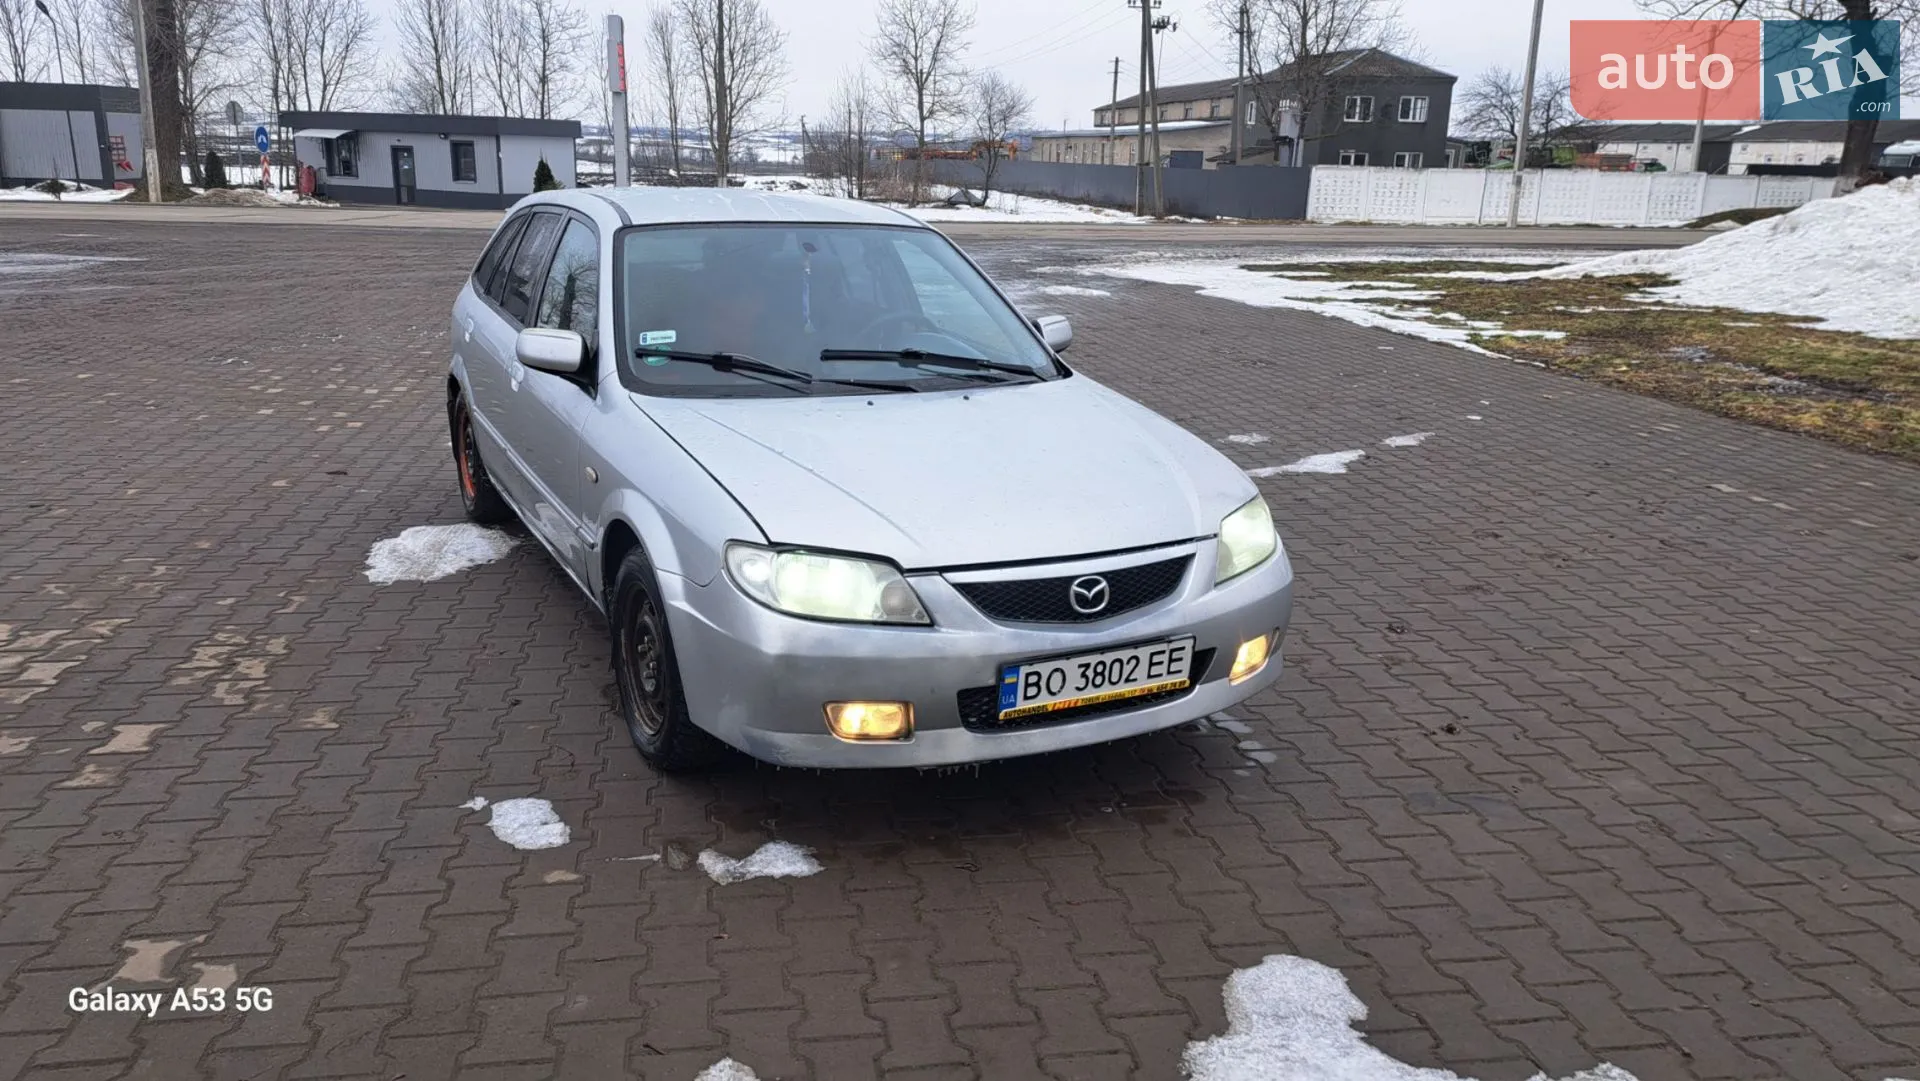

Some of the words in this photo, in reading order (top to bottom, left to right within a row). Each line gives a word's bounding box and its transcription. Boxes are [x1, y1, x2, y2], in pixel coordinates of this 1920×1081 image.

[1023, 667, 1067, 701] BO
[1075, 655, 1140, 691] 3802
[1147, 646, 1186, 679] EE
[1002, 694, 1015, 704] UA
